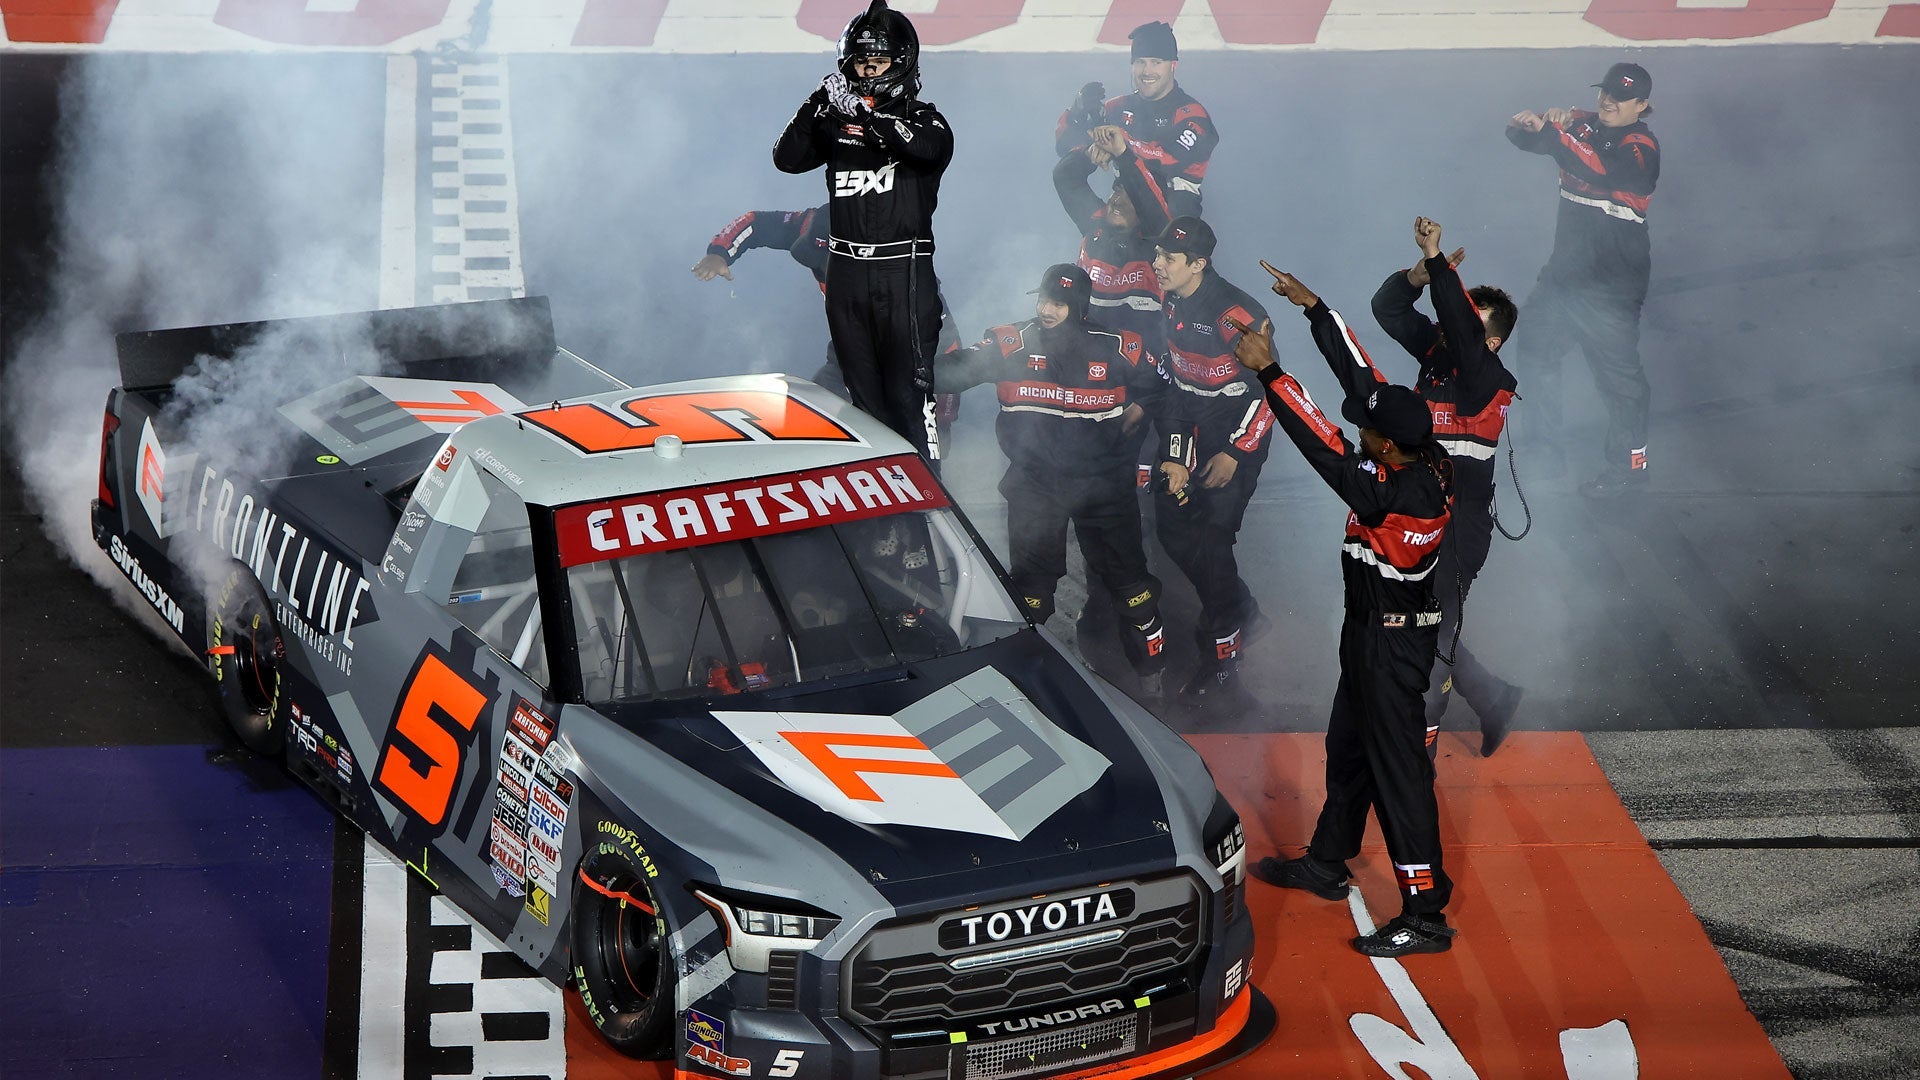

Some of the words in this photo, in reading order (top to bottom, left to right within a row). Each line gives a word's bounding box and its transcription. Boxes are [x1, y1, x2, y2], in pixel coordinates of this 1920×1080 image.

[1074, 394, 1115, 406] GARAGE
[1284, 382, 1304, 406] TRICON
[1311, 412, 1333, 437] GARAGE
[486, 454, 508, 475] COREY
[588, 464, 924, 552] CRAFTSMAN
[196, 466, 371, 650] FRONTLINE
[110, 534, 184, 634] SiriusXM
[276, 602, 334, 662] ENTERPRISES
[336, 646, 353, 677] INC
[290, 718, 317, 753] TRD
[316, 745, 338, 769] PRO
[378, 652, 488, 825] 5
[514, 710, 548, 743] CRAFTSMAN
[502, 737, 537, 773] KOOKS
[500, 760, 526, 787] LINCOLN
[503, 775, 525, 799] WELDERS
[537, 760, 559, 791] Holley
[496, 787, 527, 819] COMETIC
[533, 785, 565, 823] tilton
[493, 806, 530, 840] JESEL
[530, 806, 562, 840] SKF
[491, 842, 525, 878] CALICO
[597, 820, 659, 878] GOODYEAR
[961, 893, 1117, 945] TOYOTA
[575, 965, 605, 1031] EAGLE
[689, 1022, 722, 1041] SUNOCO
[977, 998, 1125, 1035] TUNDRA
[688, 1043, 750, 1072] ARP
[767, 1049, 805, 1078] 5
